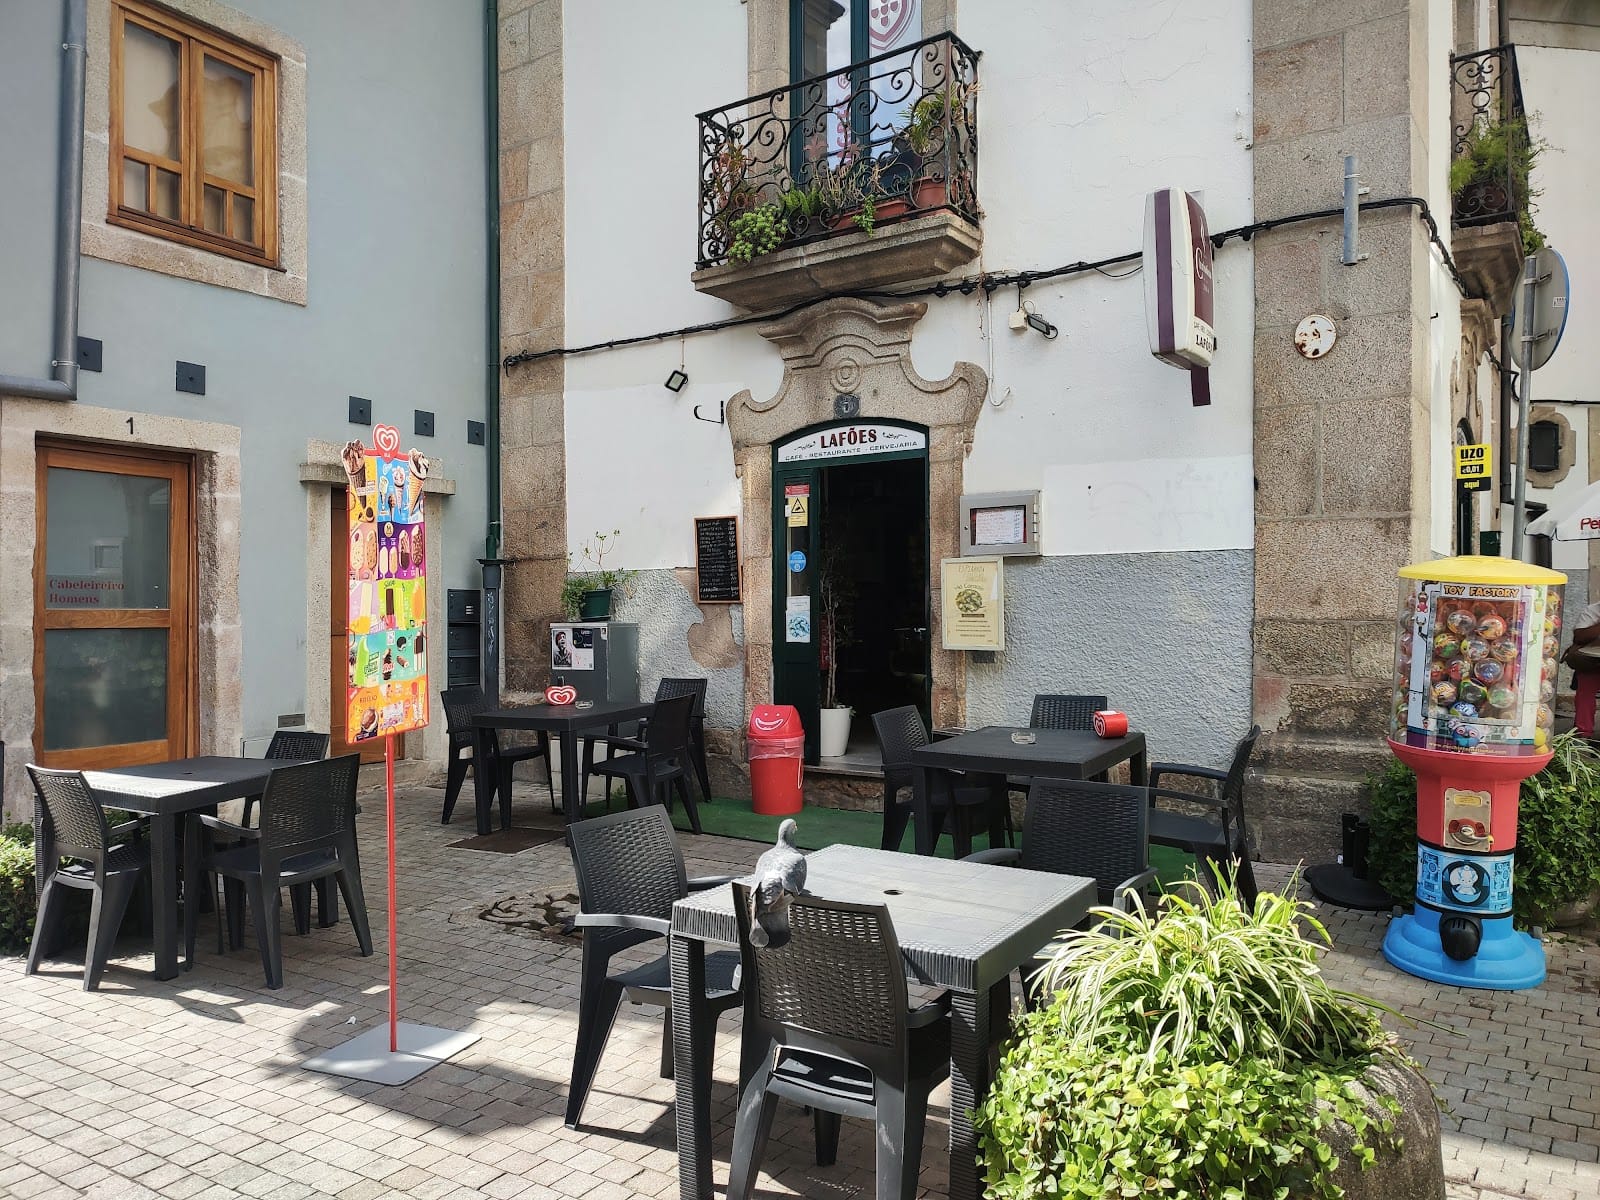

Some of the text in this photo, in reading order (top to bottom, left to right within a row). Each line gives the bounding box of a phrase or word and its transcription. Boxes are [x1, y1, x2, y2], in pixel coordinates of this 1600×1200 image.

[126, 416, 134, 435] 1
[820, 427, 877, 448] LAFÕES
[809, 447, 861, 458] RESTAURANTE
[869, 440, 918, 452] CERVEJARIA
[1463, 479, 1480, 489] aqui
[49, 578, 125, 591] Cabeleireiro
[1443, 584, 1520, 598] TOY FACTORY
[49, 592, 100, 604] Homens
